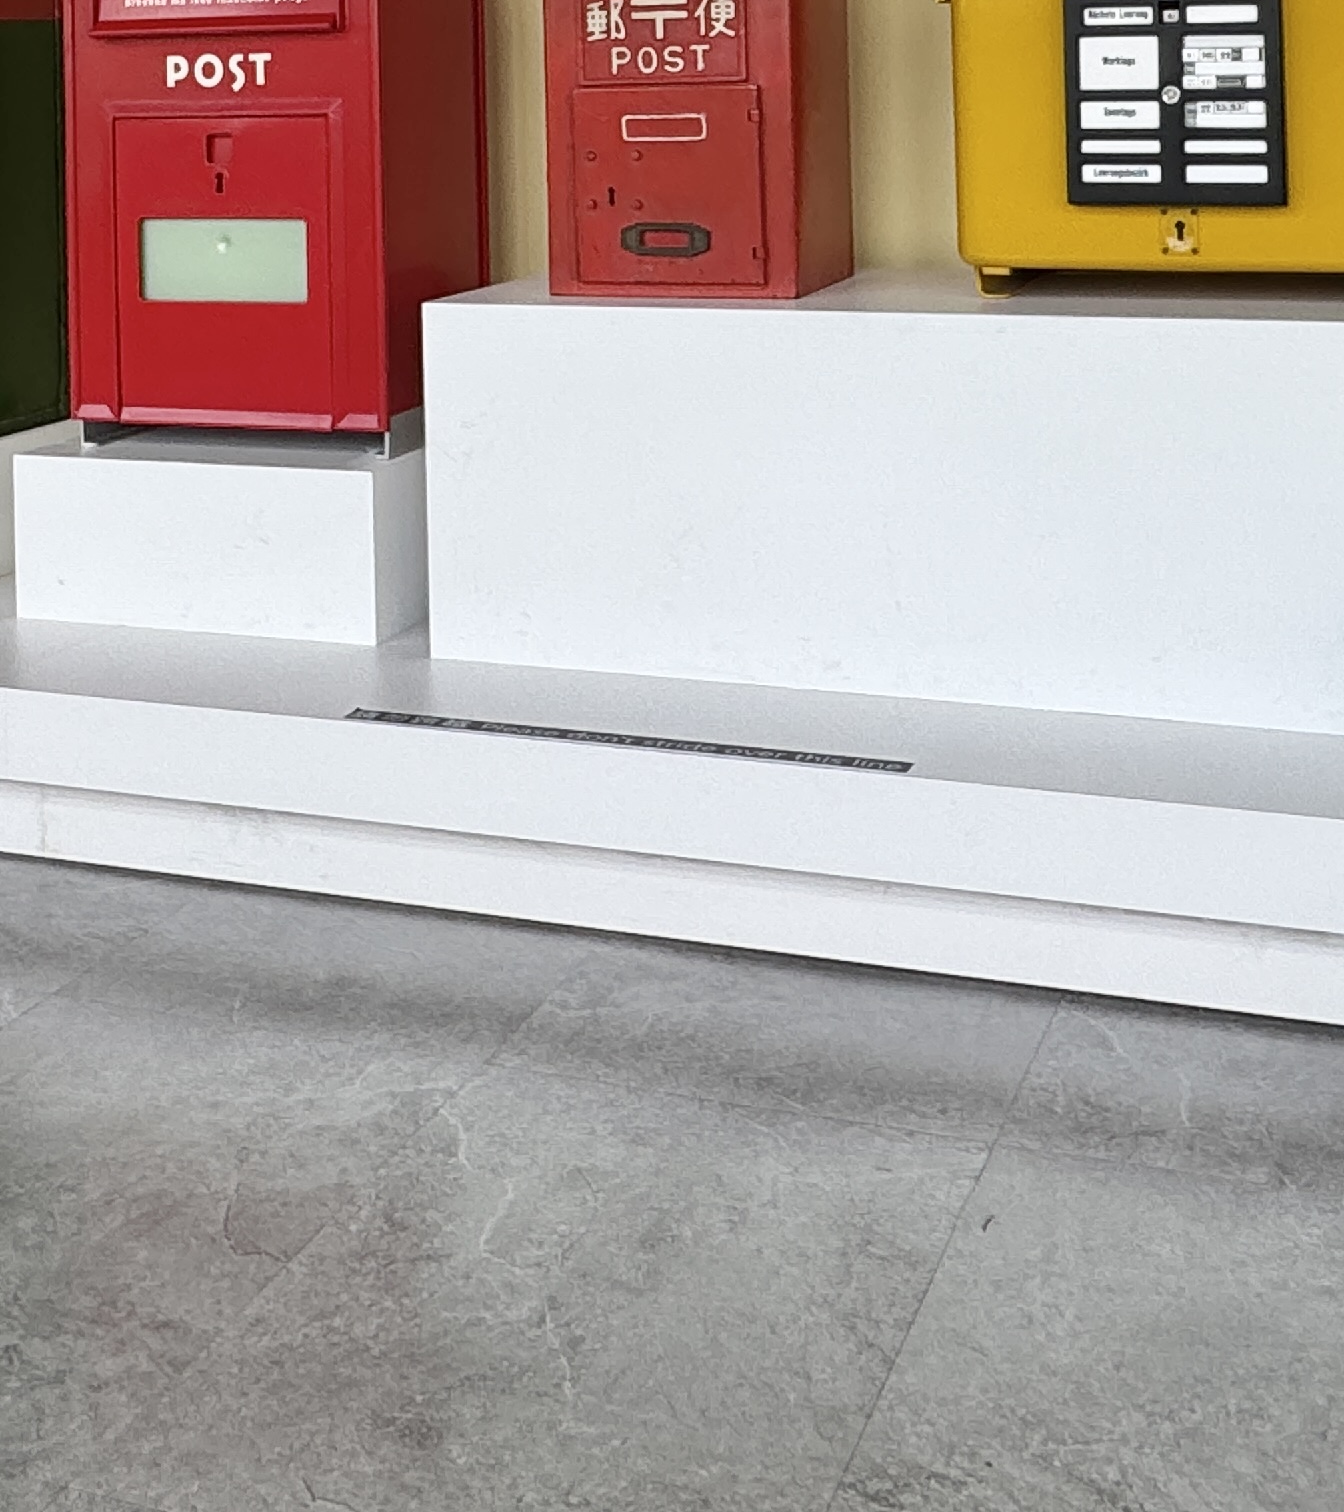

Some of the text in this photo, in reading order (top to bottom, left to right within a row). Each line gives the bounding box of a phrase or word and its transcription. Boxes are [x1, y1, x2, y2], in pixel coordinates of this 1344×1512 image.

[166, 53, 272, 92] POST
[611, 44, 710, 75] POST
[853, 758, 904, 770] line
